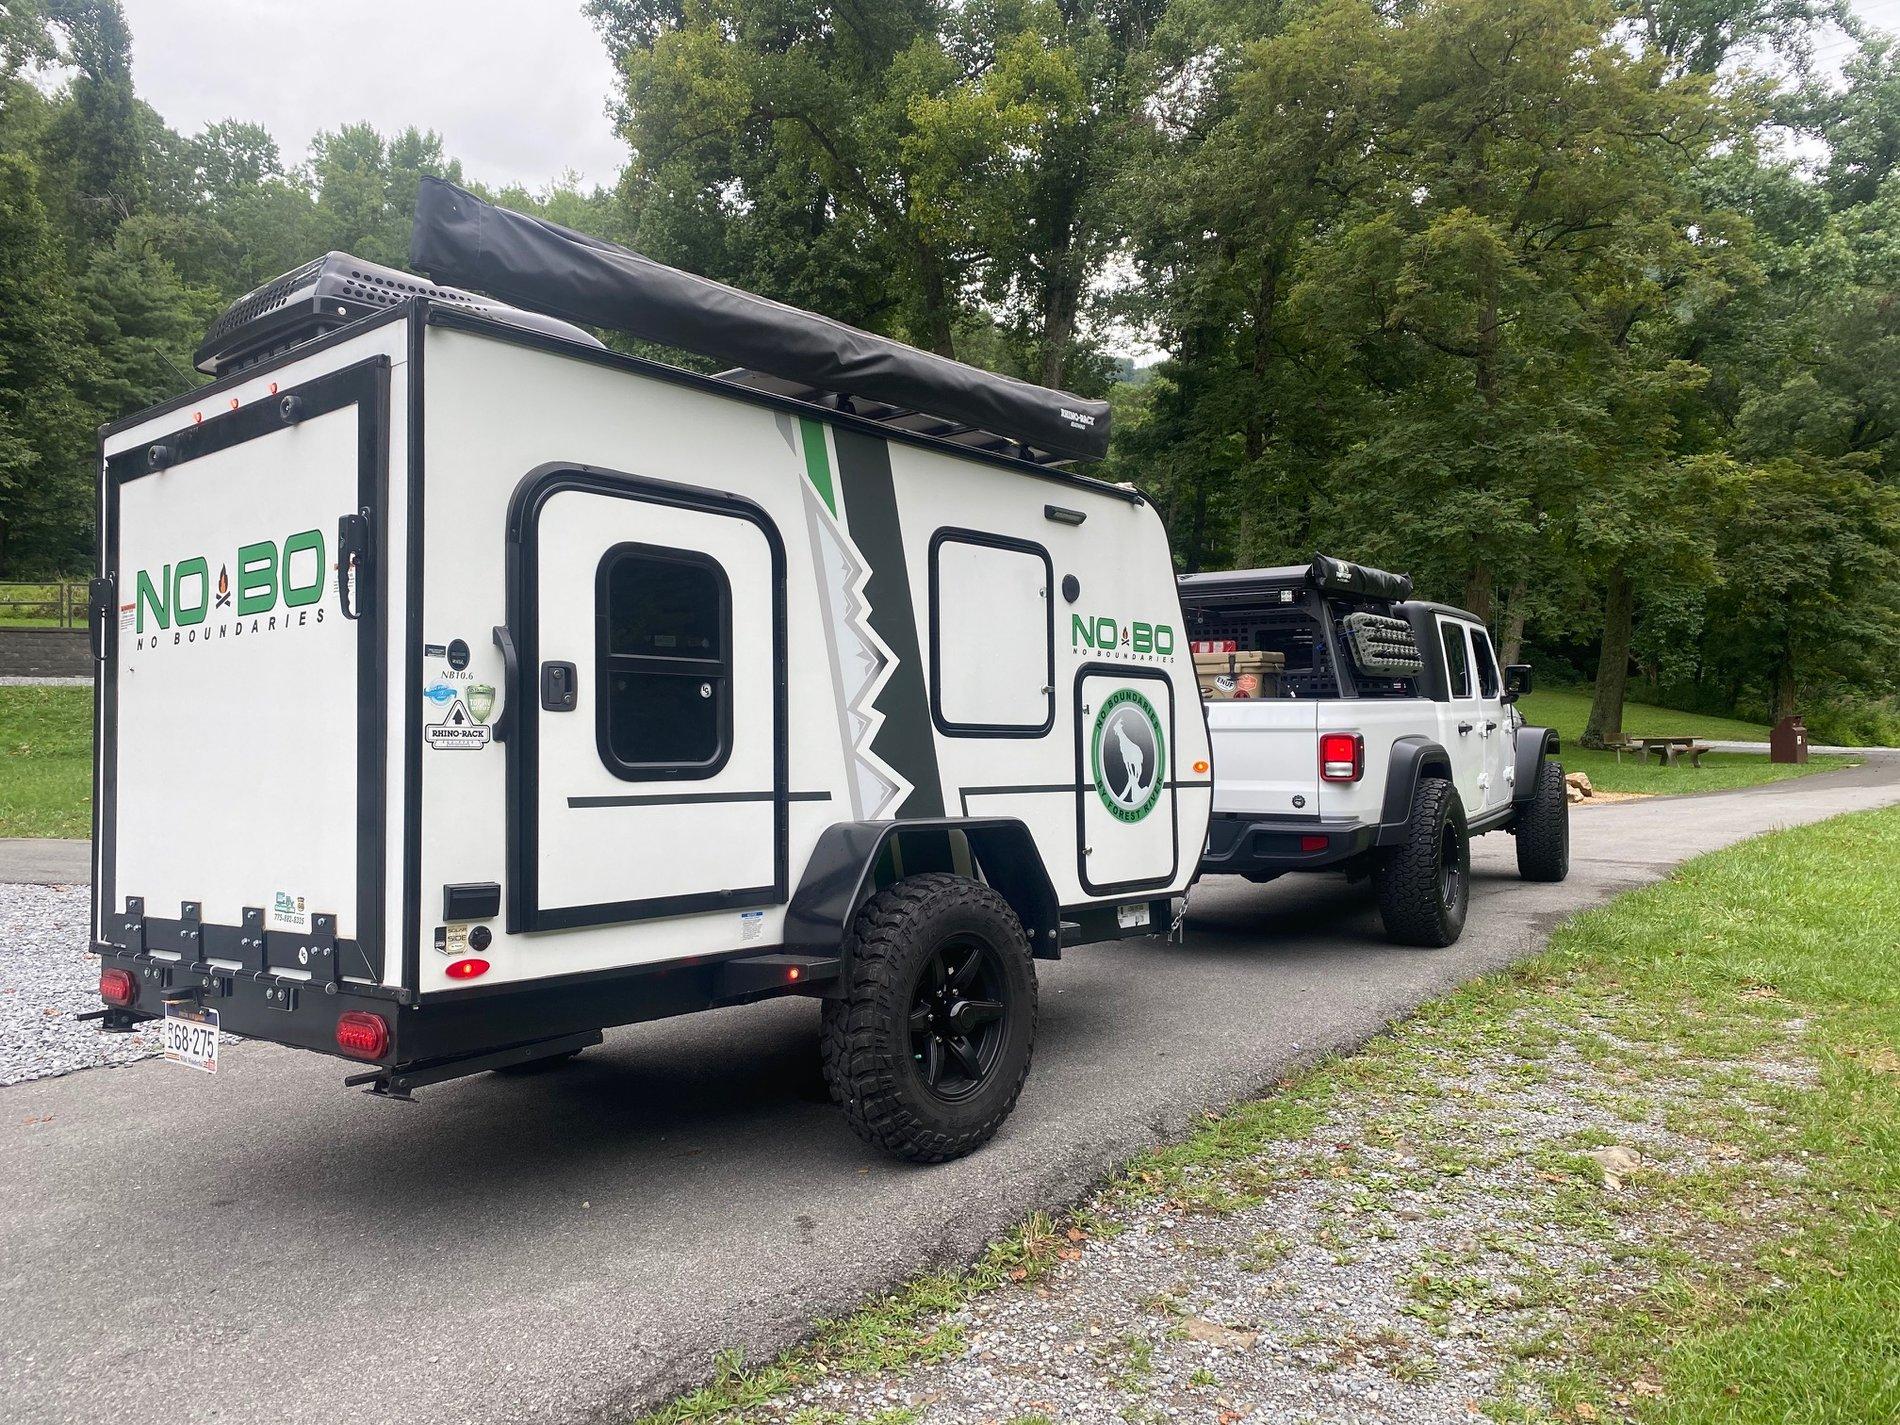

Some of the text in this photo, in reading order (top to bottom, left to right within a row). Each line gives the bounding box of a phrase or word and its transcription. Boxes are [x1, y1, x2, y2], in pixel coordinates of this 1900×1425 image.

[136, 528, 326, 634] NO BO
[136, 608, 325, 651] NO BOUNDARIES
[1072, 613, 1174, 656] NO BO
[441, 671, 474, 680] NB10.6
[1072, 648, 1175, 664] NO BOUNDARIES
[1096, 691, 1159, 730] NO BOUNDARIES
[431, 729, 485, 738] RHINO-RACK
[1097, 776, 1163, 821] BY FOREST RIVER
[447, 934, 467, 942] SIDE
